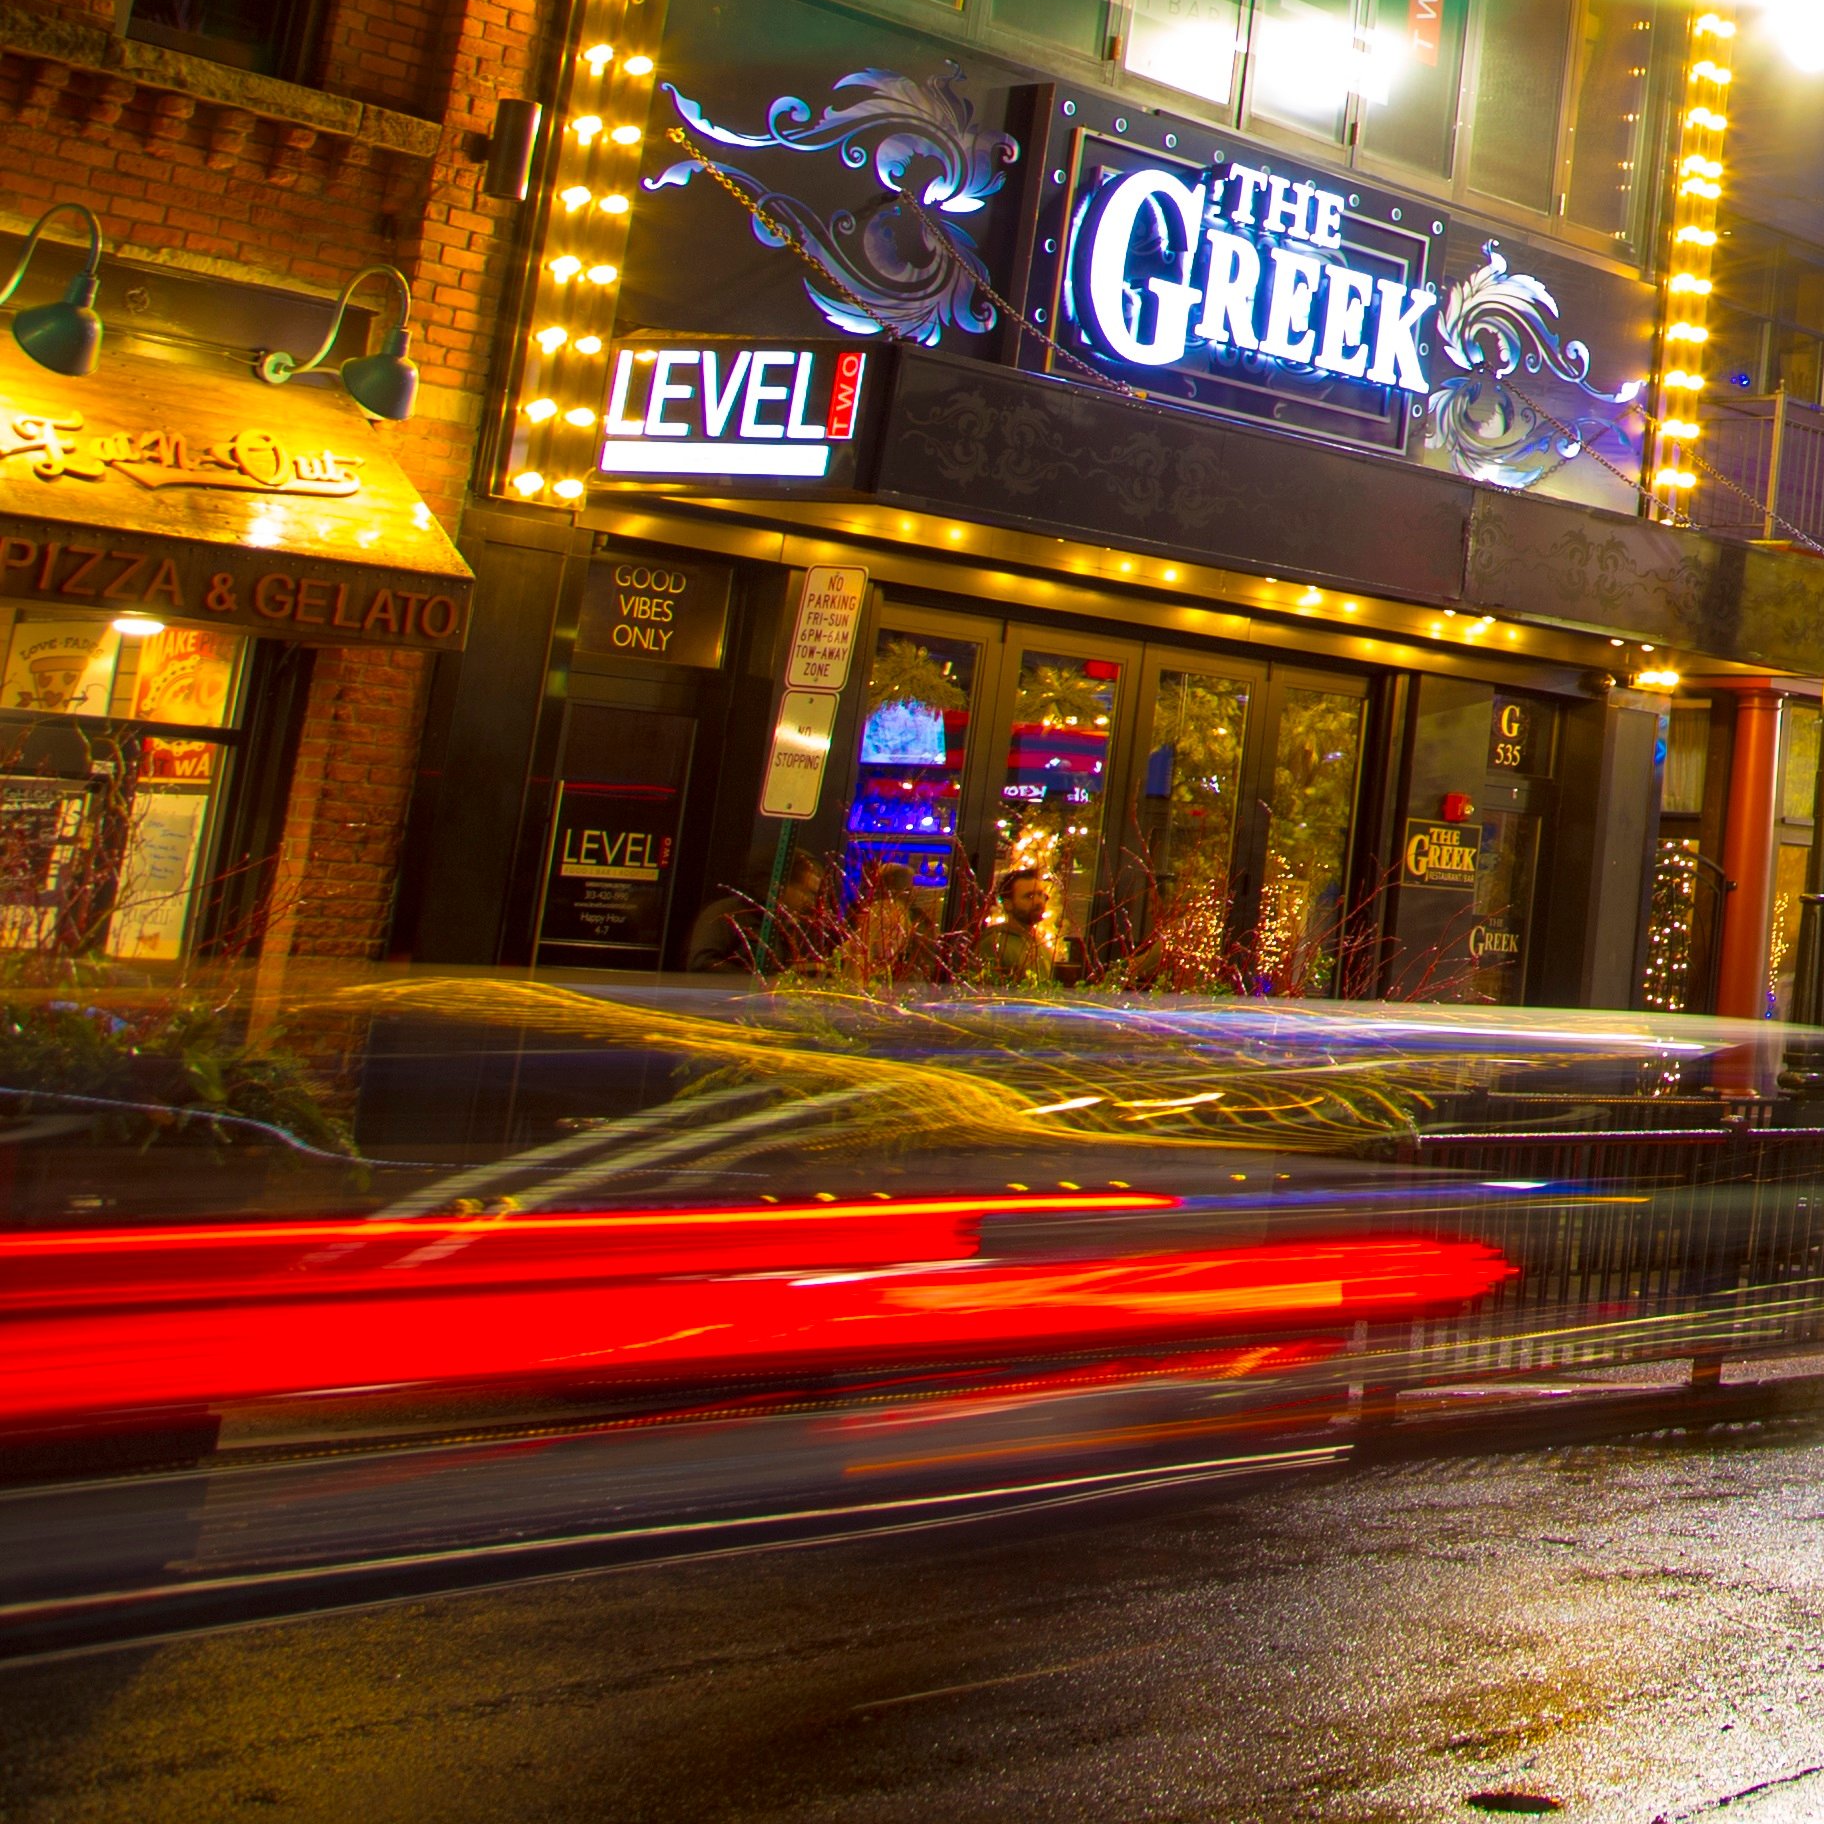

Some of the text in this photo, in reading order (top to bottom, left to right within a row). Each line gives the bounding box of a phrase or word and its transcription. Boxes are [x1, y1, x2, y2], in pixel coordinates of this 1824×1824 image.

[1229, 162, 1345, 250] THE
[1090, 168, 1437, 394] GREEK
[606, 349, 827, 439] LEVEL
[830, 354, 861, 437] TWO
[0, 536, 459, 639] PIZZA & GELATO
[616, 564, 687, 594] GOOD
[827, 576, 844, 592] NO
[620, 594, 674, 622] VIBES
[807, 593, 857, 611] PARKING
[806, 612, 850, 627] FRI-SUN
[613, 624, 674, 651] ONLY
[800, 628, 849, 644] 6PM-6AM
[796, 644, 848, 661] TOW-AWAY
[803, 662, 830, 677] ZONE
[1501, 704, 1520, 738] G
[775, 752, 821, 771] STOPPING
[1495, 743, 1521, 767] 535
[563, 828, 658, 868] LEVEL
[1429, 827, 1461, 845] THE
[661, 837, 672, 865] TWO
[1407, 834, 1477, 875] GREEK
[1469, 926, 1520, 957] GREEK
